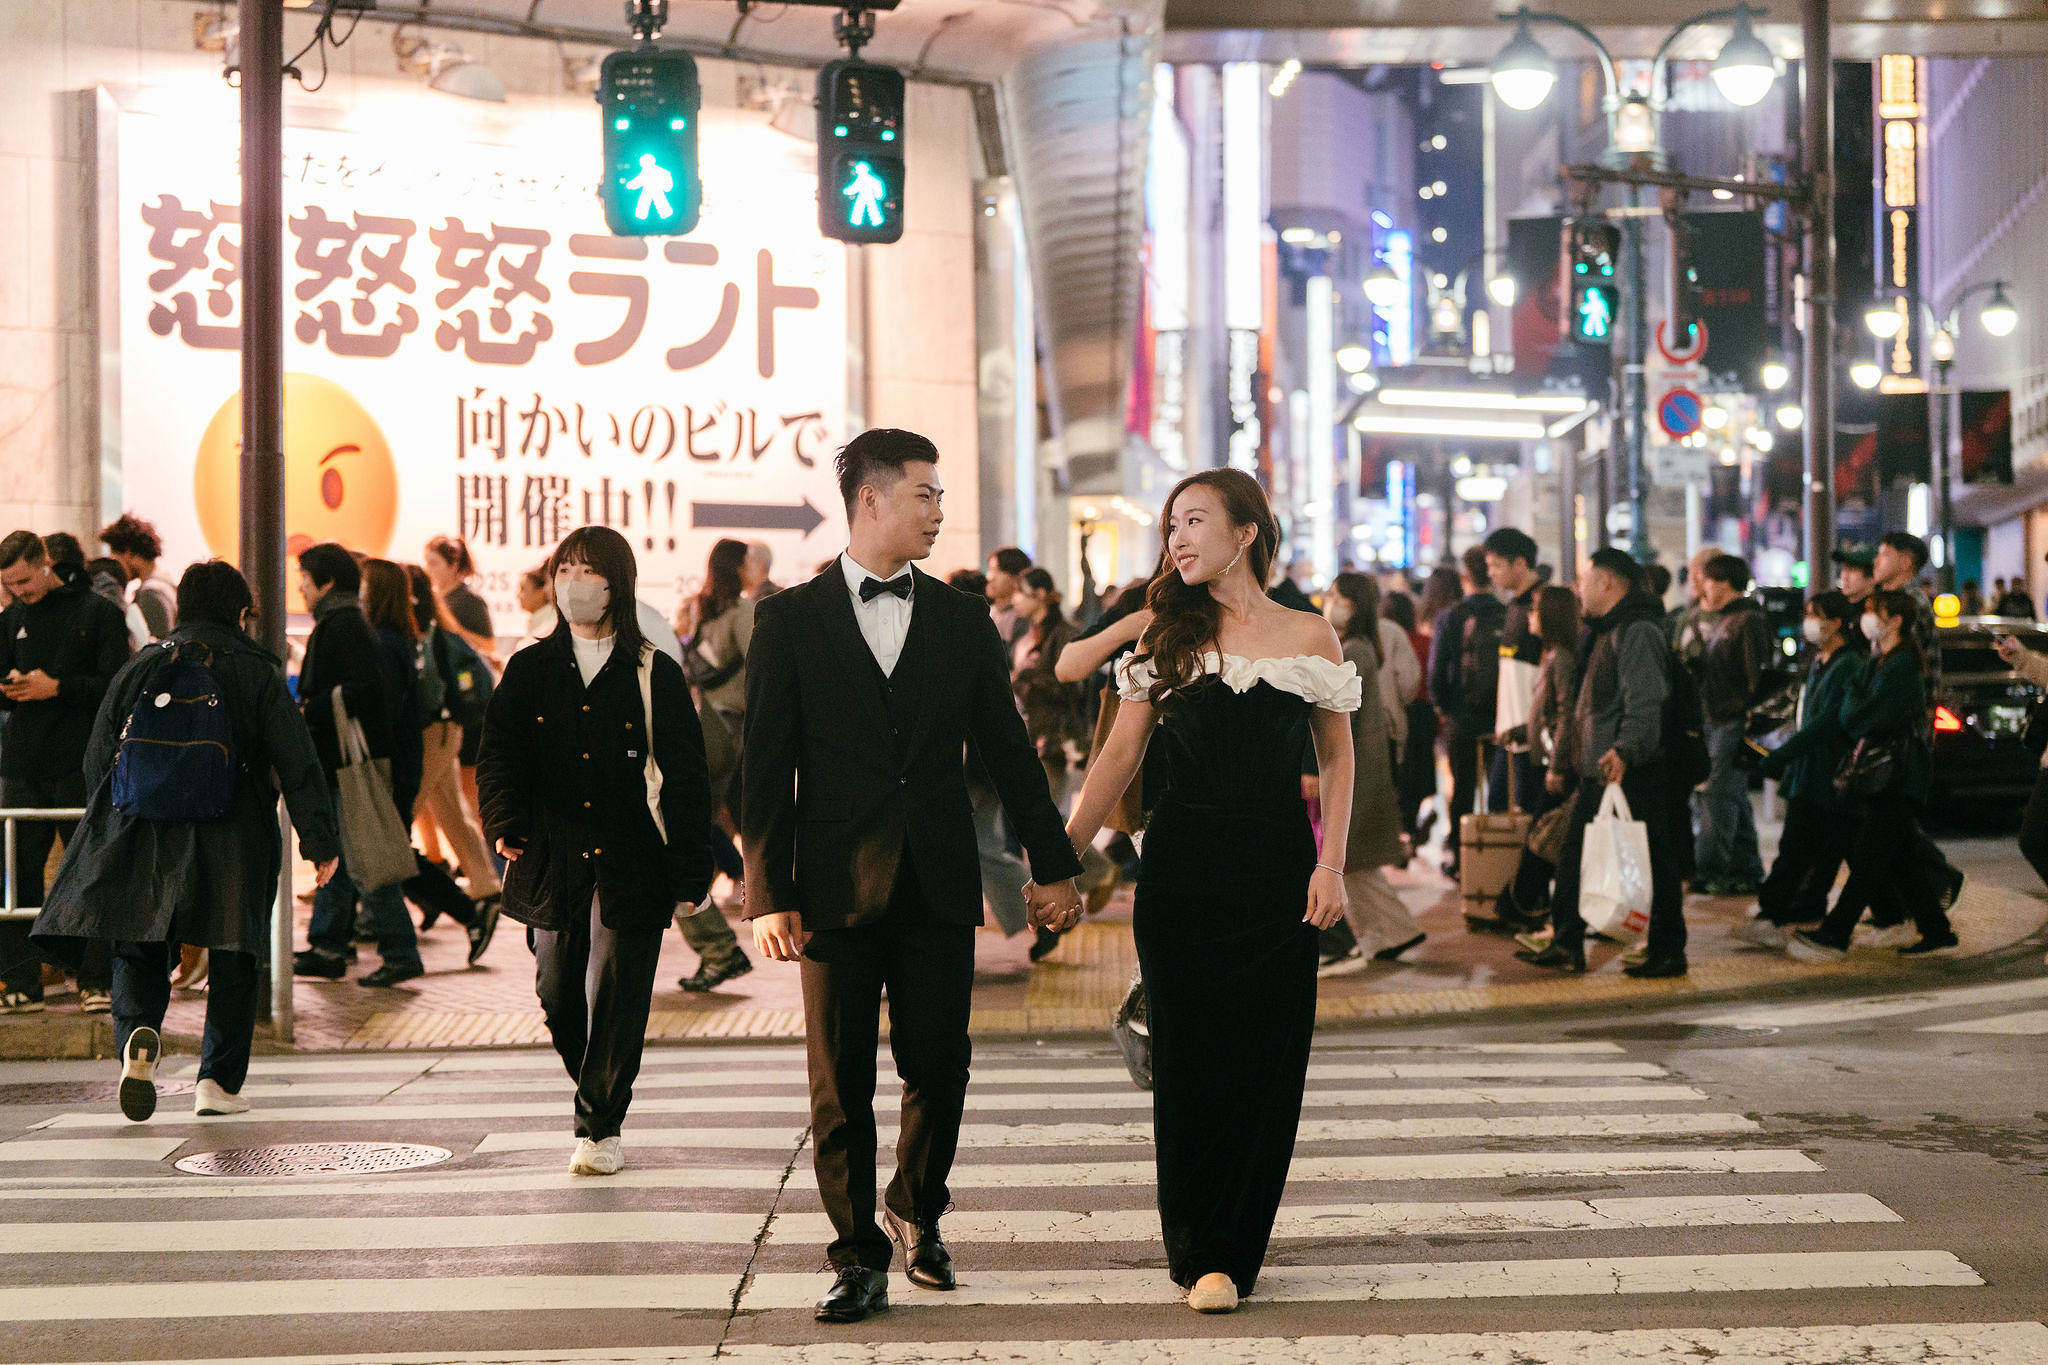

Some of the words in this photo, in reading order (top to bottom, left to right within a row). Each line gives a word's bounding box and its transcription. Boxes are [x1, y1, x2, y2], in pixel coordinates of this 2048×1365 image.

[142, 193, 820, 379] 怒怒怒ラント
[456, 386, 829, 467] 向かいのビルで
[456, 473, 678, 551] 開催中!!
